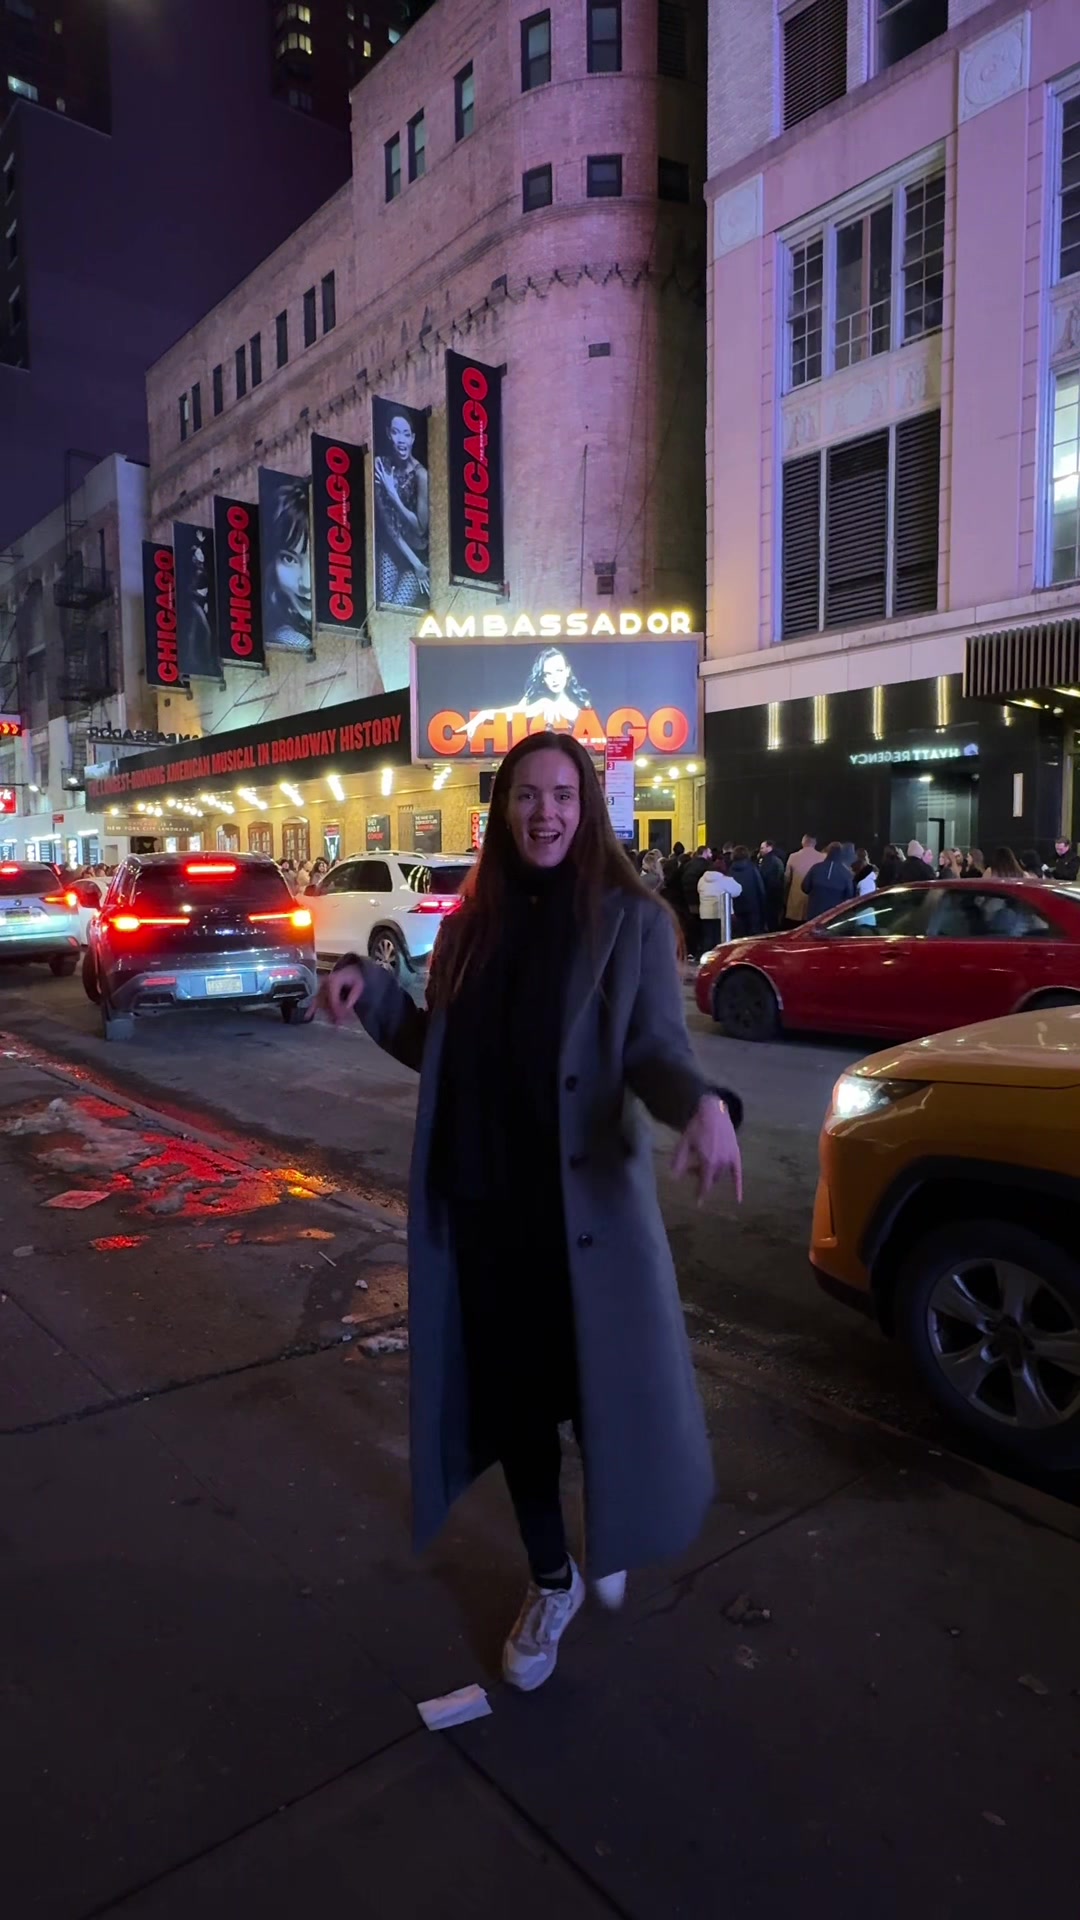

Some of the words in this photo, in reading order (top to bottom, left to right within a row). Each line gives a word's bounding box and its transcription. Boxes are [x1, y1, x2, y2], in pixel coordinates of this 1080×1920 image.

[325, 446, 354, 621] CHICAGO
[462, 366, 491, 574] CHICAGO
[154, 550, 179, 683] CHICAGO
[227, 505, 253, 656] CHICAGO
[418, 611, 691, 638] AMBASSADOR
[166, 755, 210, 783] AMERICAN
[212, 745, 256, 774] MUSICAL
[257, 743, 270, 767] IN
[272, 729, 337, 764] BROADWAY
[340, 715, 402, 752] HISTORY
